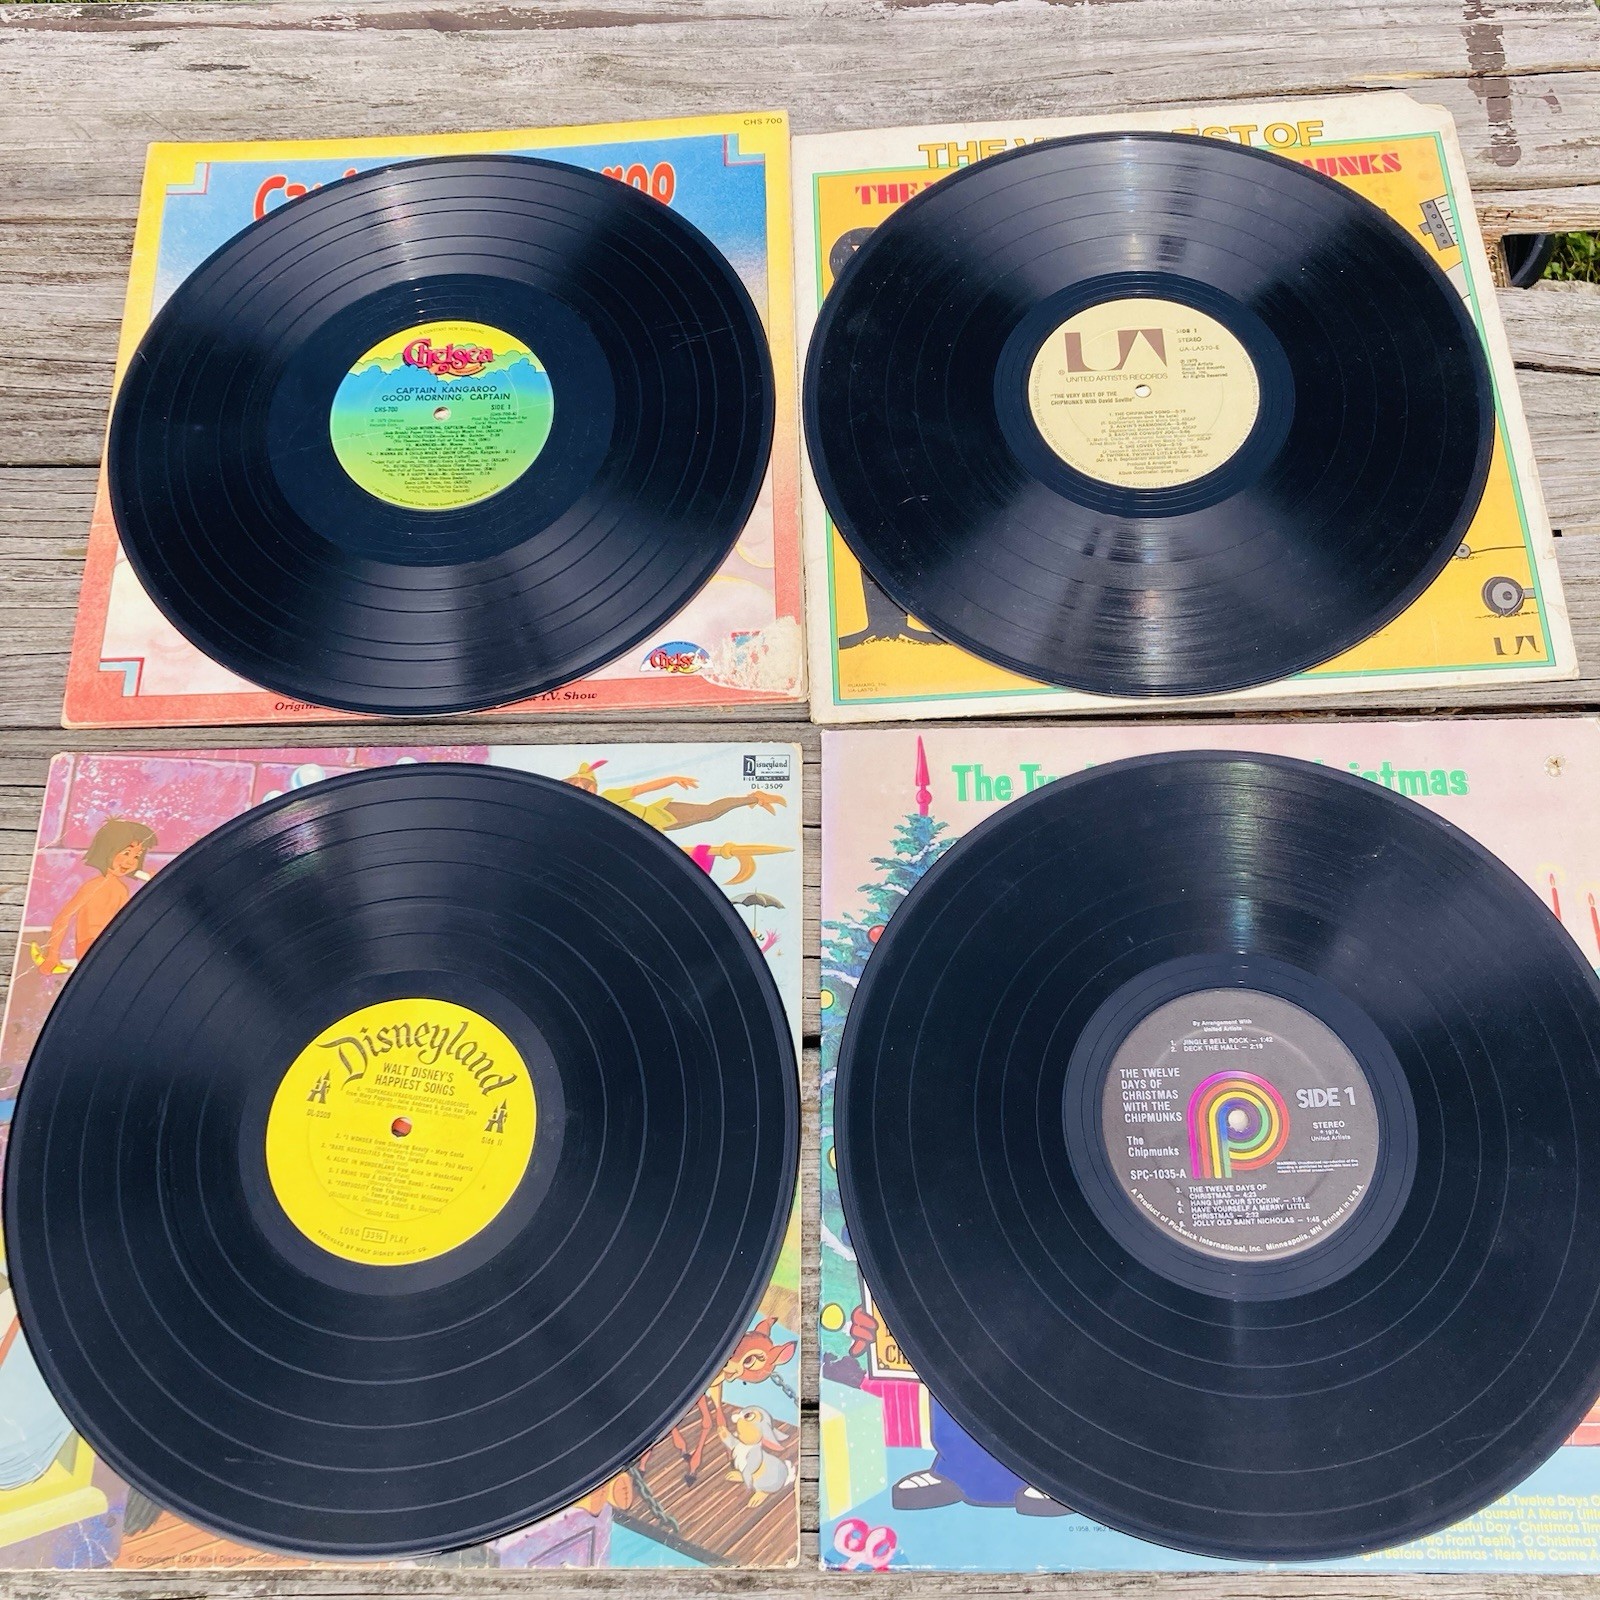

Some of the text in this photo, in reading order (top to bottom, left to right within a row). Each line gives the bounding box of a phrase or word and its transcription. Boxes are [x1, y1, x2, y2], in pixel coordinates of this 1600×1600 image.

[1264, 120, 1323, 148] OF
[402, 339, 494, 373] Chelsea
[563, 692, 597, 700] Show
[951, 764, 1013, 801] The
[316, 1021, 518, 1096] Disneyland
[384, 1062, 454, 1082] WALT DISNEY'S
[1120, 1068, 1180, 1078] THE TWELVE
[375, 1074, 455, 1096] HAPPIEST SONGS
[1122, 1079, 1162, 1089] DAYS OF
[1123, 1090, 1178, 1100] CHRISTMAS
[1296, 1087, 1355, 1108] SIDE 1
[1123, 1102, 1170, 1111] WITH THE
[1125, 1112, 1182, 1122] CHIPMUNKS
[1313, 1121, 1345, 1129] STEREO
[1127, 1136, 1144, 1145] The
[1128, 1146, 1179, 1158] Chipmunks
[1131, 1169, 1186, 1180] SPC-1035-A
[1137, 1193, 1161, 1217] Product
[1160, 1215, 1169, 1223] of
[1168, 1219, 1198, 1241] Pickwick
[1199, 1236, 1248, 1253] International,
[1266, 1234, 1310, 1251] Minneapolis,
[1310, 1226, 1322, 1236] MN
[1322, 1207, 1344, 1226] Printed
[1342, 1201, 1350, 1209] in
[1348, 1183, 1364, 1201] U.S.A.
[340, 1226, 359, 1236] LONG
[389, 1234, 409, 1244] PLAY
[1512, 1494, 1554, 1506] Twelve
[1557, 1495, 1589, 1508] Days
[1527, 1508, 1536, 1519] A
[1539, 1508, 1573, 1521] Merry
[1486, 1521, 1510, 1535] Day
[1519, 1521, 1580, 1533] Christmas
[1446, 1534, 1475, 1546] Front
[1523, 1535, 1533, 1547] O
[1536, 1535, 1597, 1547] Christmas
[1427, 1548, 1487, 1560] Christmas
[1494, 1549, 1523, 1560] Here
[1526, 1549, 1546, 1560] We
[1548, 1549, 1586, 1560] Come
